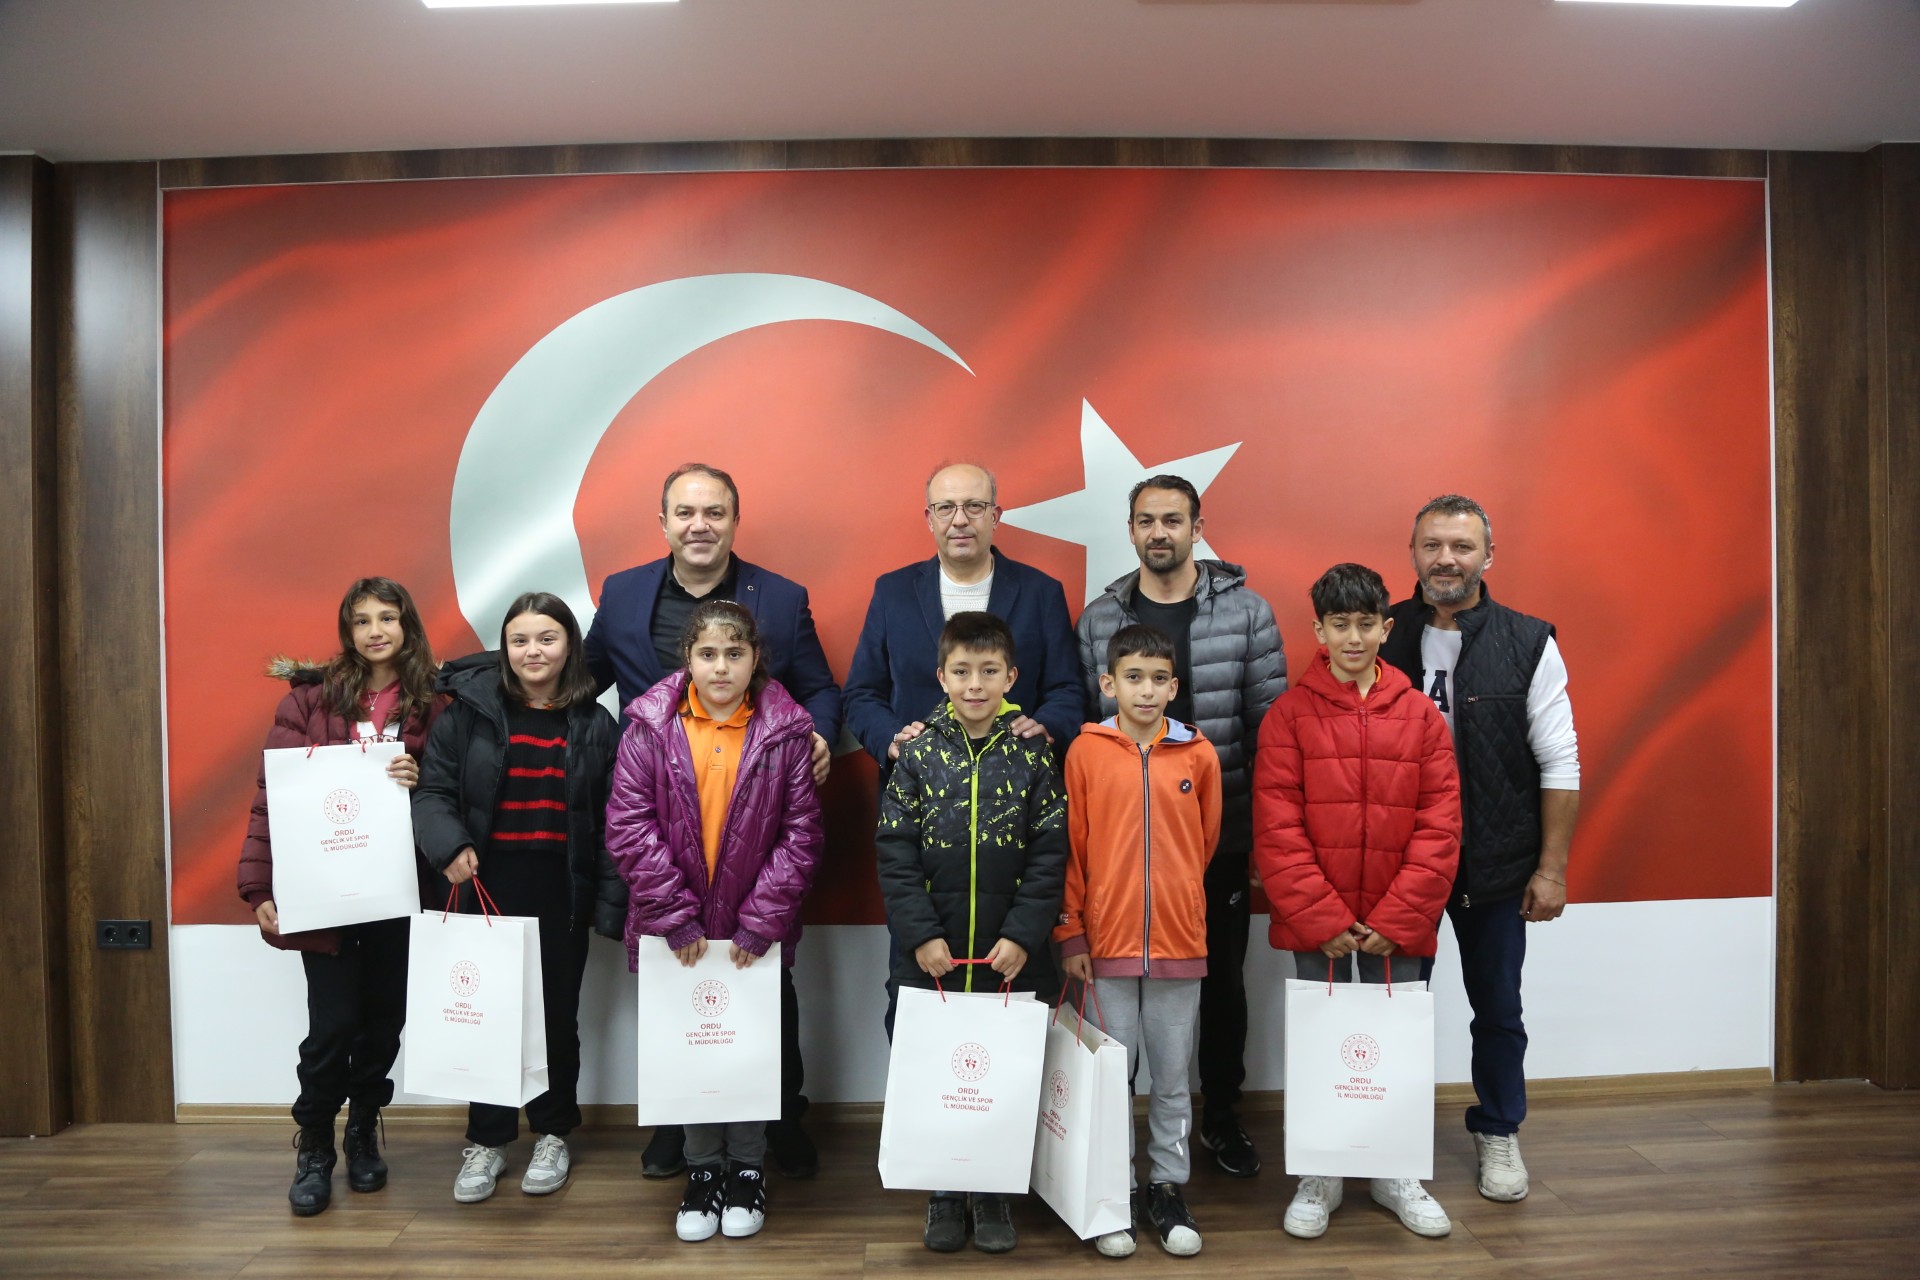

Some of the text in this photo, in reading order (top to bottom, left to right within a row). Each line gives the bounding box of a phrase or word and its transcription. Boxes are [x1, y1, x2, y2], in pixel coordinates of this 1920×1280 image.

[334, 829, 355, 837] ORDU
[454, 1001, 472, 1009] ORDU
[1349, 1077, 1372, 1085] ORDU
[957, 1087, 979, 1096] ORDU
[941, 1094, 967, 1102] GENÇLİK
